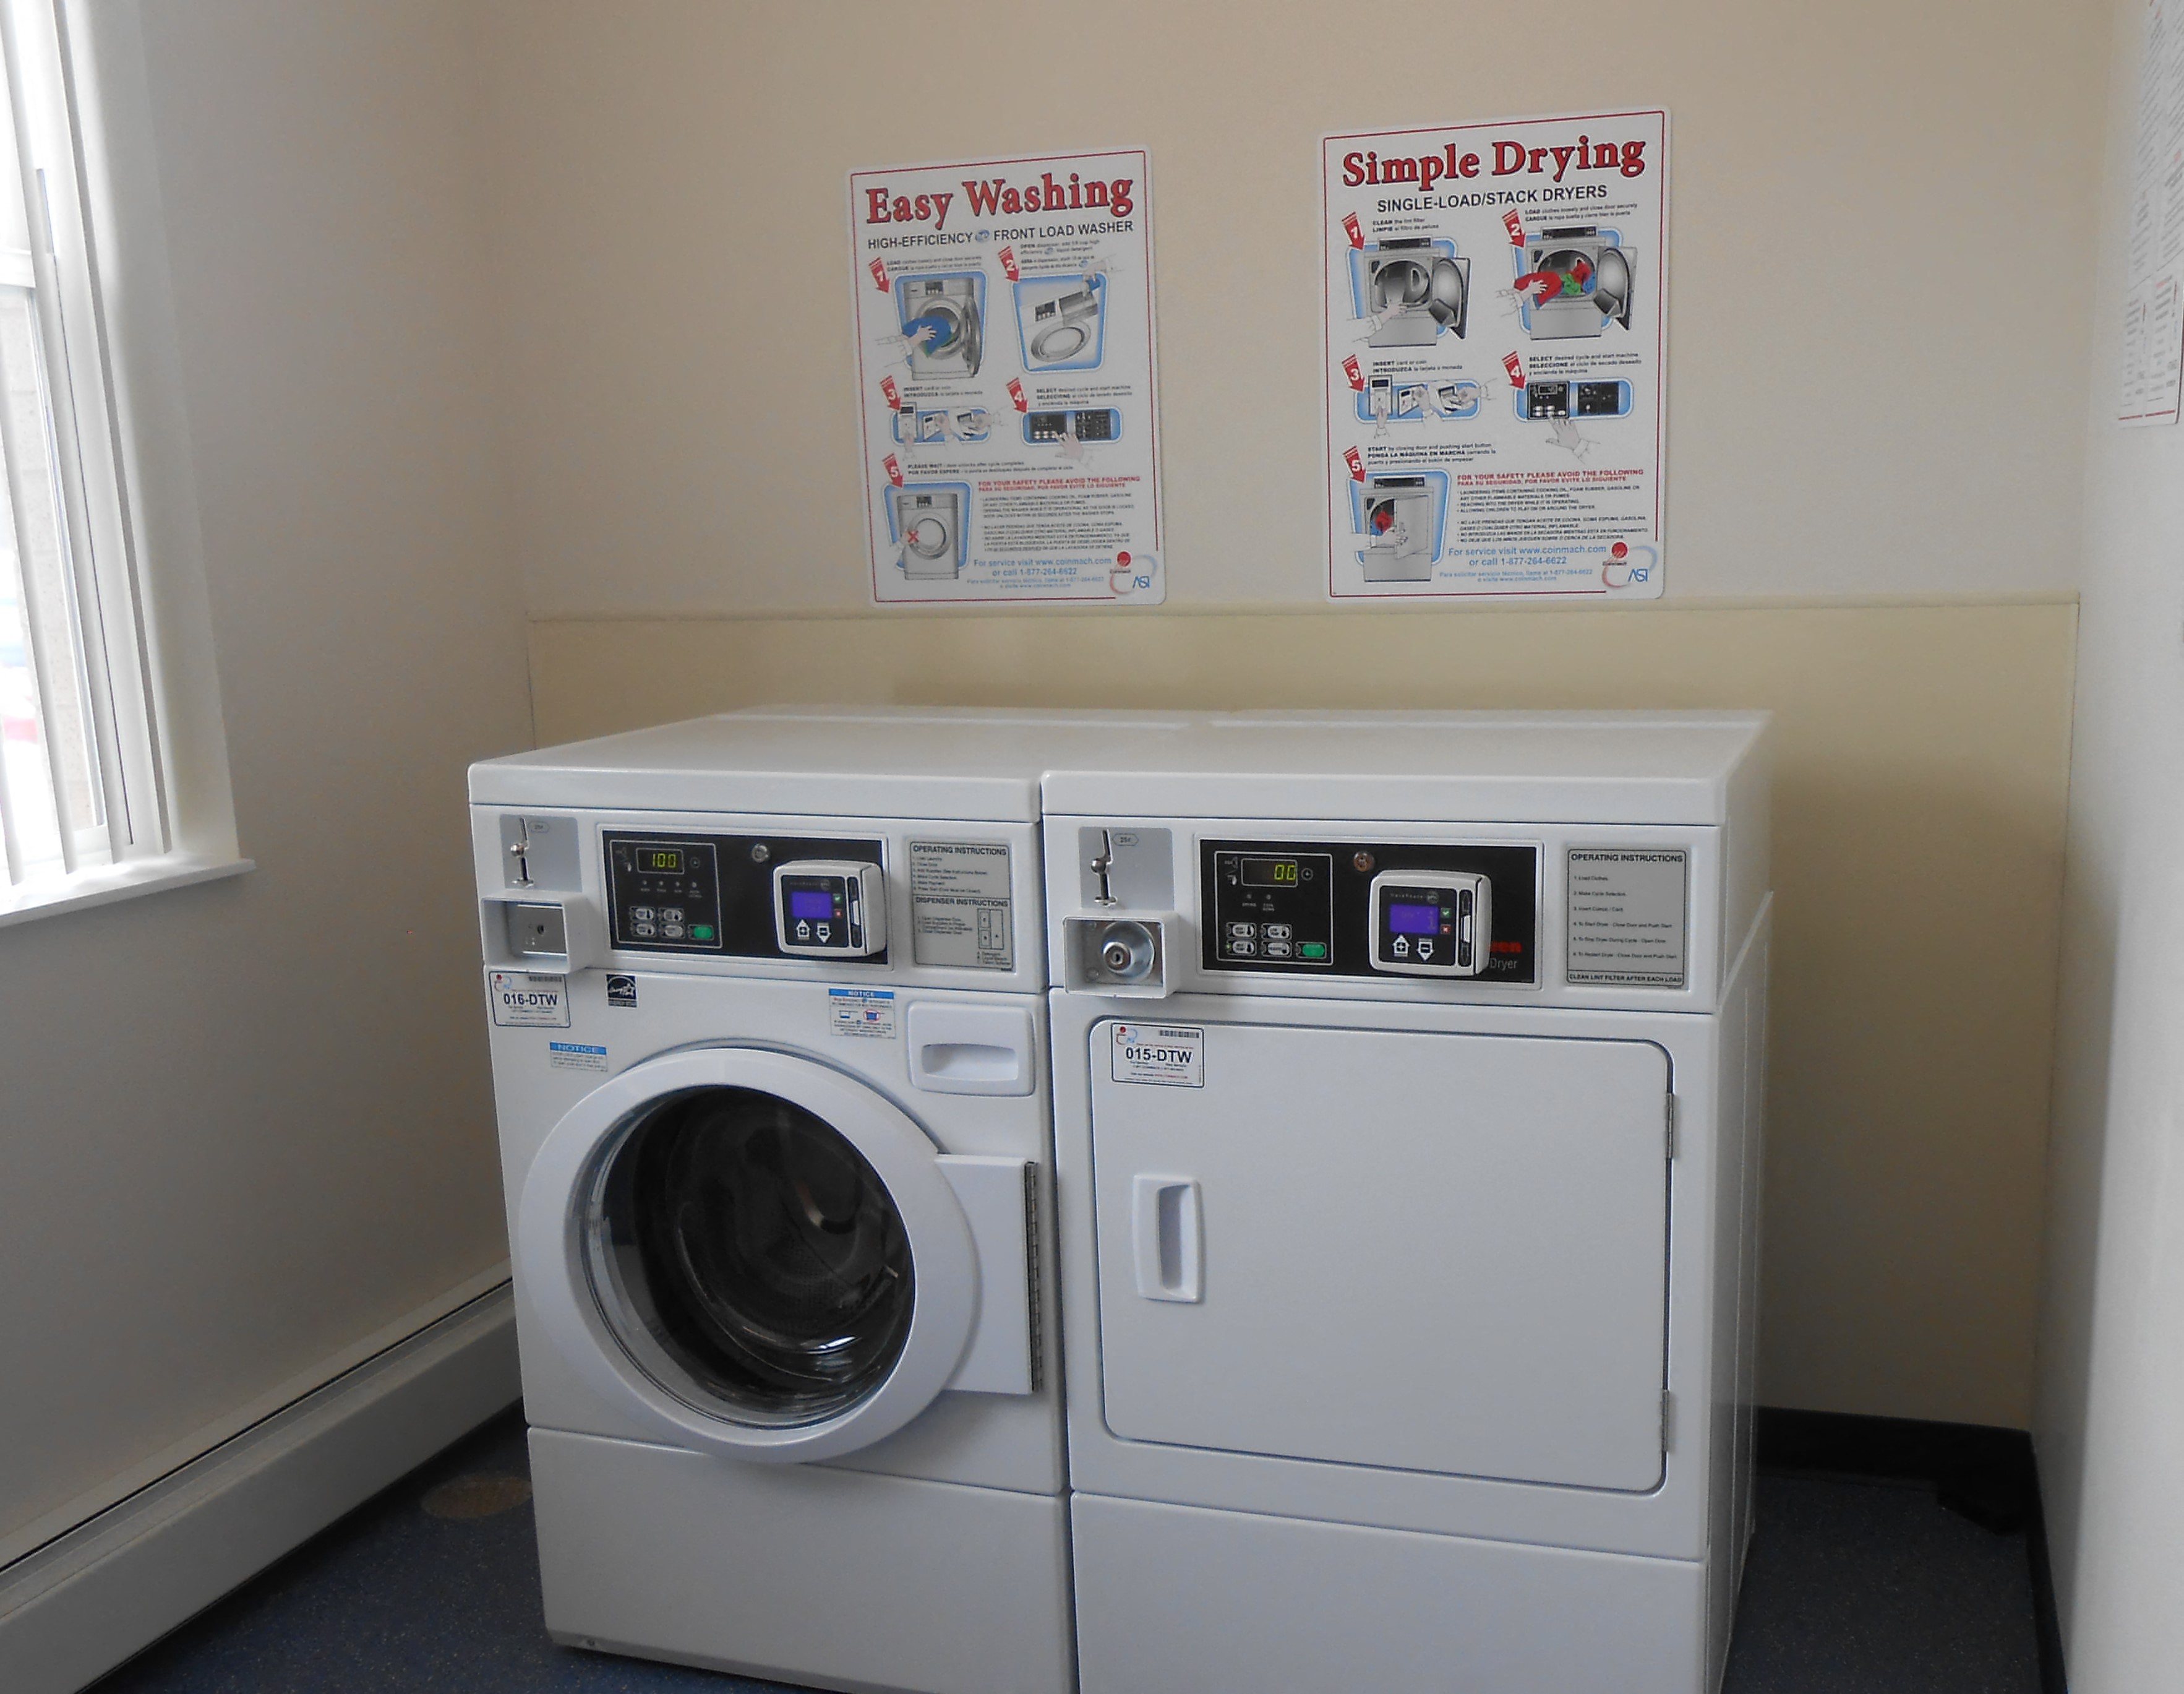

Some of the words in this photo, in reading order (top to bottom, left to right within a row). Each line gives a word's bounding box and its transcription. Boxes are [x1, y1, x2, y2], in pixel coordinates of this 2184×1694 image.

[1343, 143, 1480, 191] Simple
[1491, 135, 1646, 183] Drying
[866, 187, 954, 231] Easy
[961, 173, 1133, 217] Washing
[1377, 189, 1538, 213] SINGLE-LOAD/STACK
[1543, 185, 1608, 202] DRYERS
[868, 233, 973, 249] HIGH-EFFICIENCY
[994, 228, 1035, 241] FRONT
[1039, 225, 1074, 238] LOAD
[1078, 221, 1133, 235] WASHER
[1351, 226, 1358, 239] 1
[1510, 223, 1521, 236] 2
[1006, 259, 1014, 271] 2
[1351, 369, 1360, 381] 3
[1511, 366, 1522, 377] 4
[888, 388, 896, 400] 3
[1351, 460, 1361, 471] 5
[890, 466, 898, 478] 5
[1448, 548, 1462, 556] For
[1519, 545, 1606, 554] www.coinmach.com
[1501, 556, 1567, 566] 1-877-264-6622
[1020, 567, 1077, 576] 1-877-264-6622
[913, 845, 953, 854] OPERATING
[955, 846, 1006, 855] INSTRUCTIONS
[652, 853, 677, 868] 100
[1570, 853, 1619, 861] OPERATING
[1621, 854, 1683, 862] INSTRUCTIONS
[1274, 864, 1296, 881] 00
[956, 898, 1008, 907] INSTRUCTIONS
[1489, 957, 1517, 971] Dryer
[503, 993, 557, 1005] 016-DTW
[1126, 1047, 1192, 1064] 015-DTW
